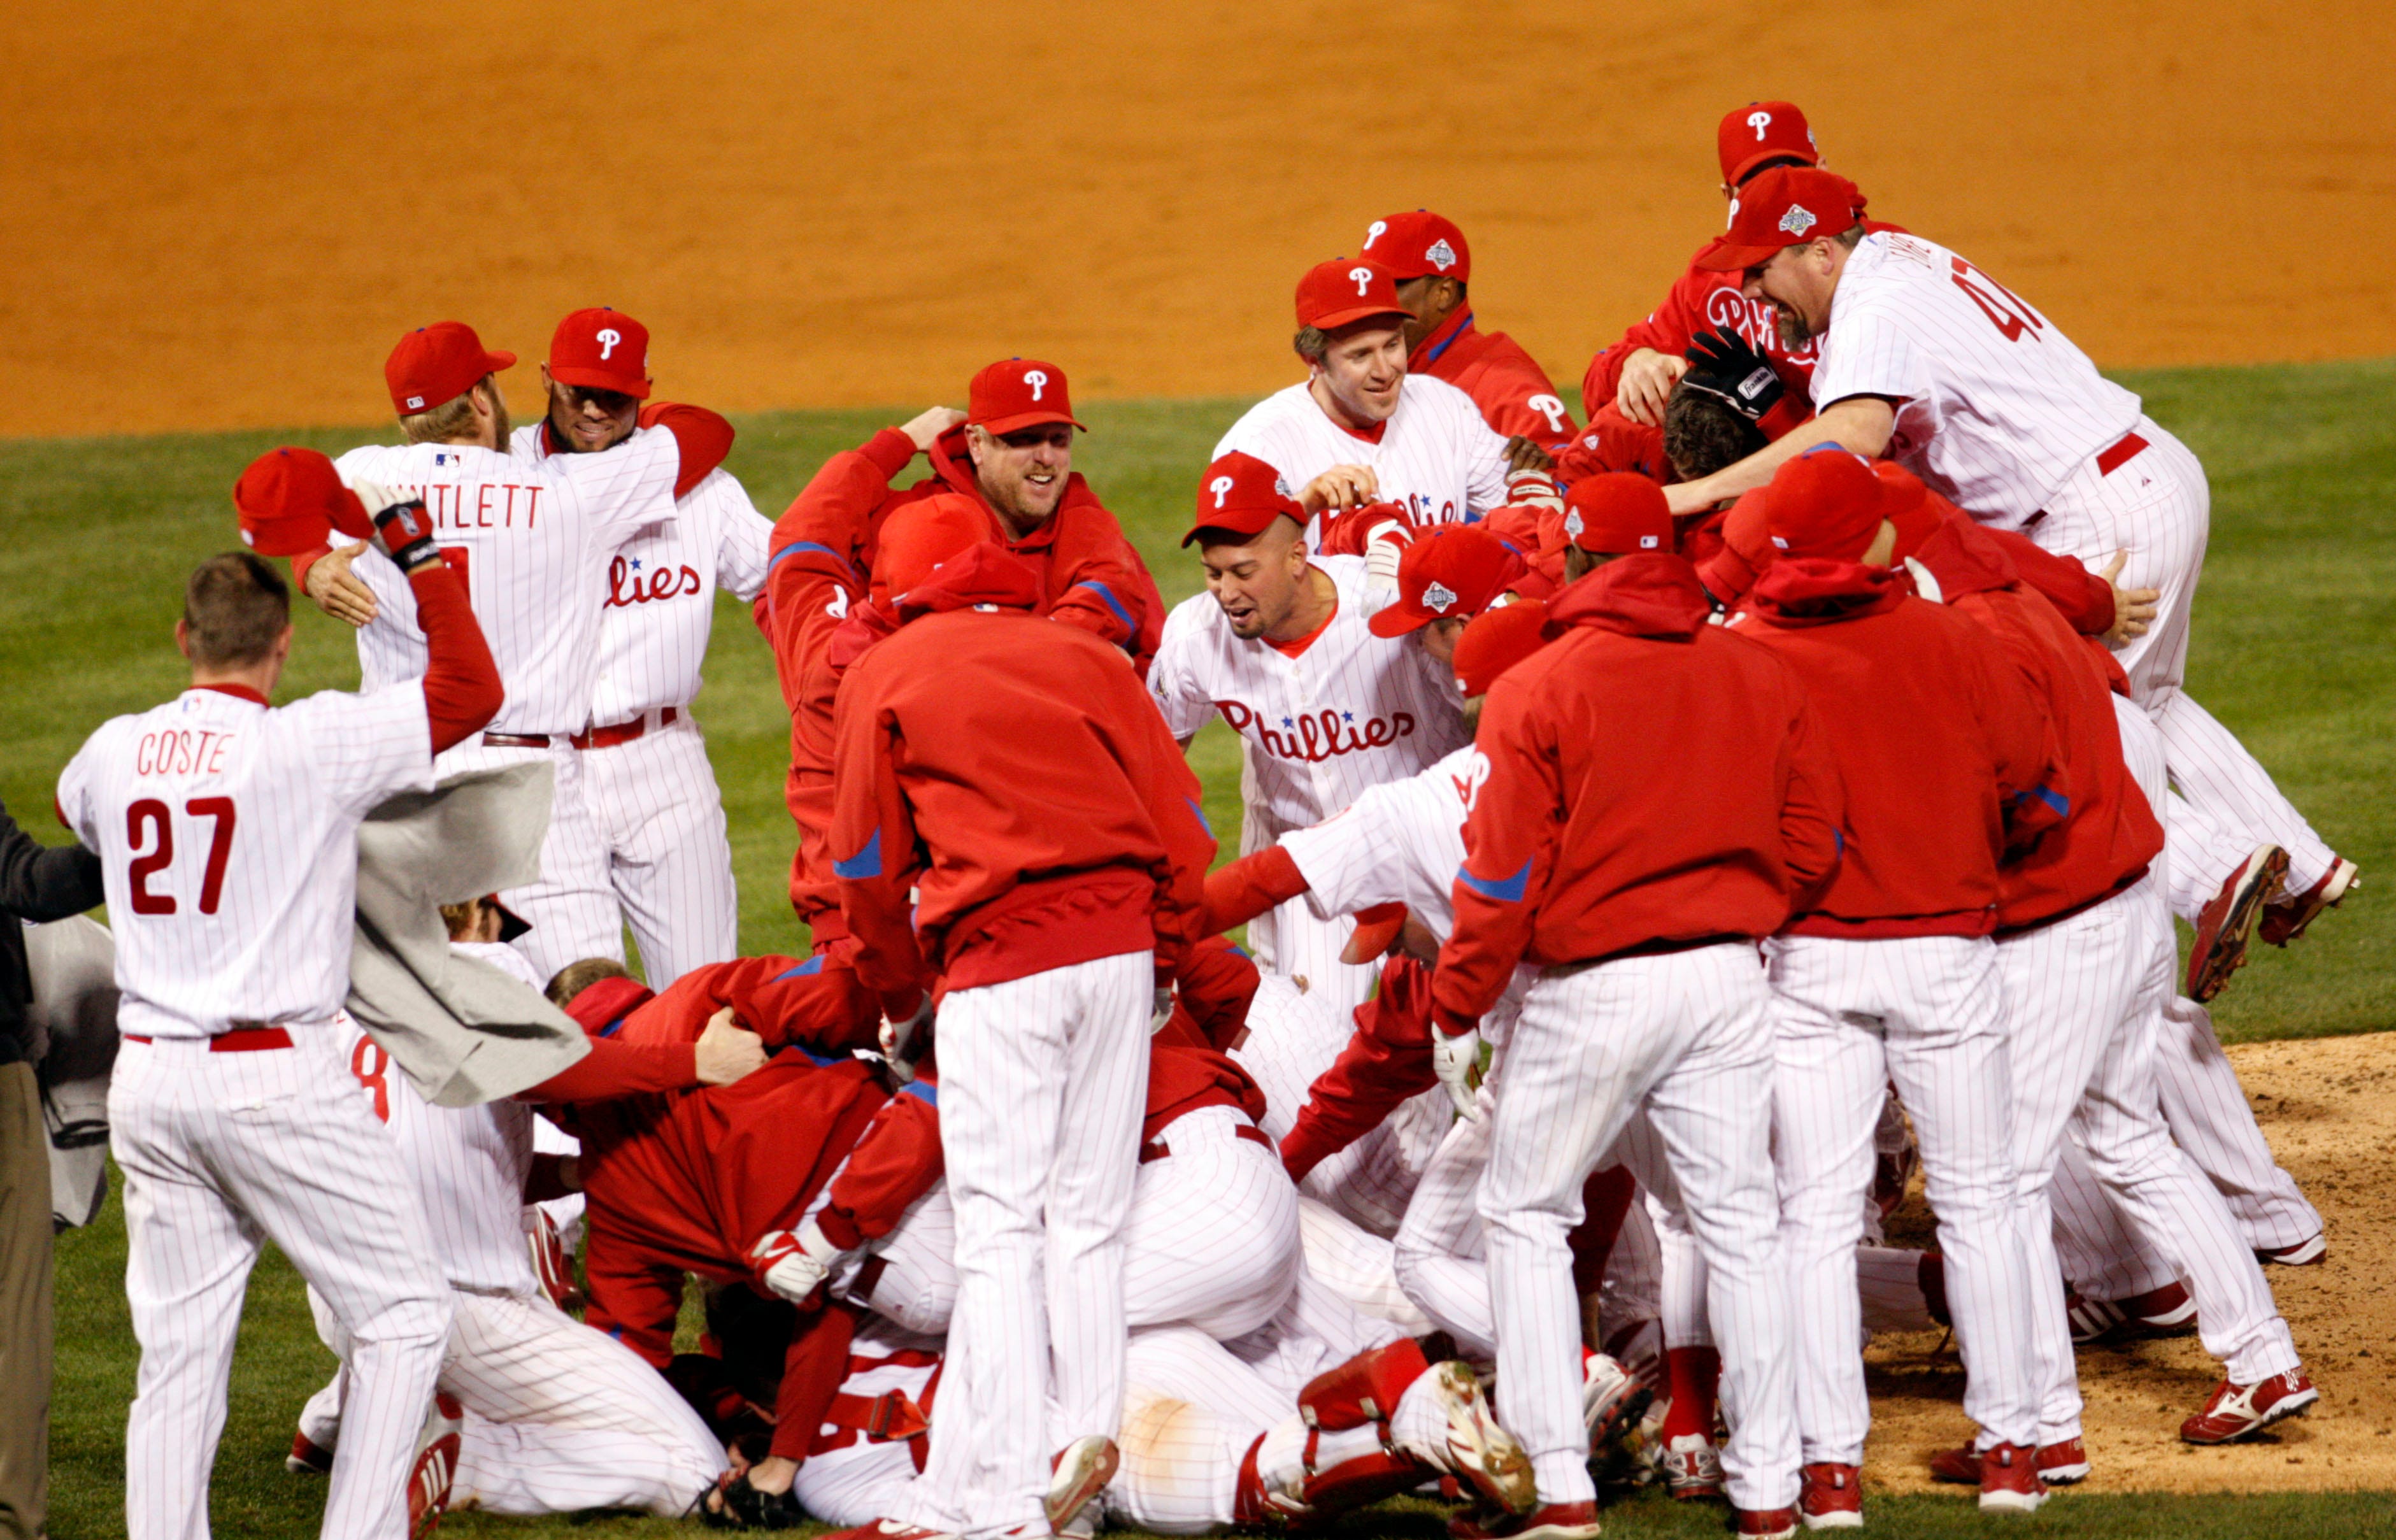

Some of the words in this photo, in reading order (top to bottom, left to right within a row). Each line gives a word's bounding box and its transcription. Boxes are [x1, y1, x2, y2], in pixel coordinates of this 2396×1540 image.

[1747, 111, 1772, 141] P
[1363, 220, 1387, 250] P
[1349, 267, 1373, 296] P
[596, 329, 620, 360] P
[1023, 370, 1048, 401] P
[1527, 394, 1565, 432] P
[1209, 476, 1234, 509] P
[1212, 699, 1415, 764] Phillies
[137, 729, 235, 777] COSTE
[126, 795, 237, 916] 27
